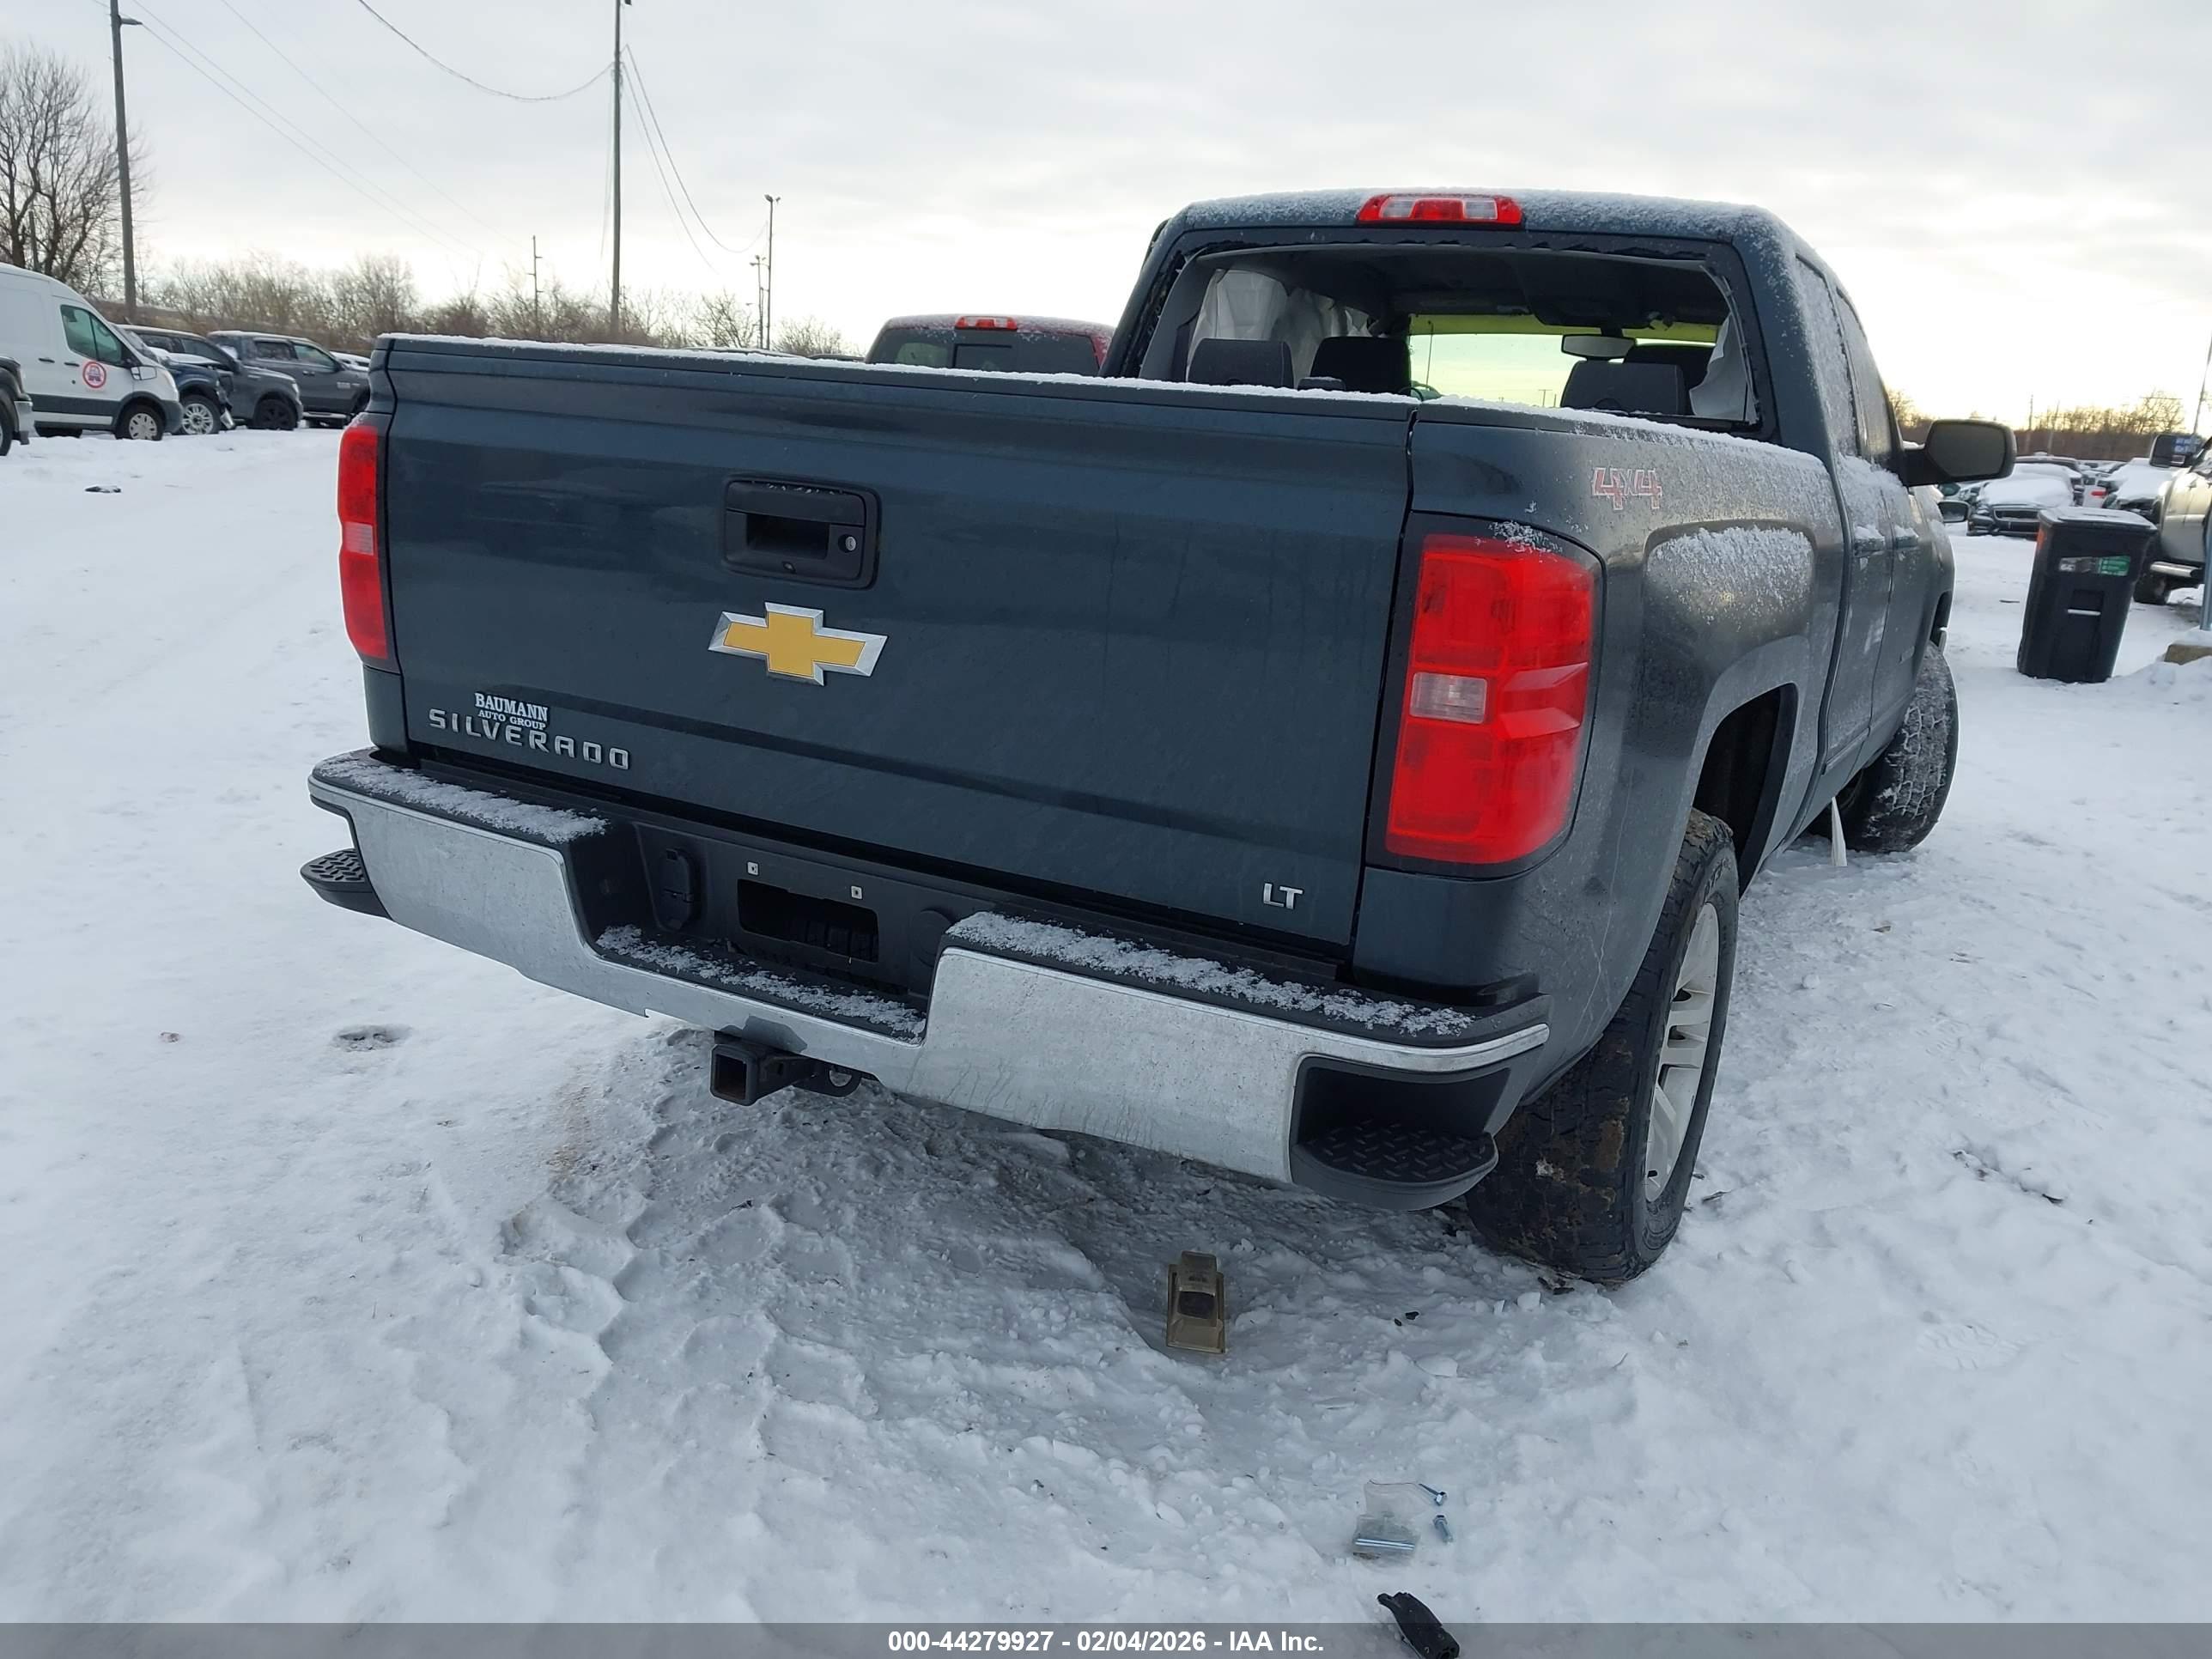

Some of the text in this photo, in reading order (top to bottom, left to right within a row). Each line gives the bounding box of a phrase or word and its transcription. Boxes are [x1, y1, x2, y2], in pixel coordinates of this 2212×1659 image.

[474, 692, 549, 722] BAUMANN
[477, 709, 546, 730] AUTO GROUP
[429, 708, 629, 769] SILVERADO
[1263, 883, 1303, 909] LT
